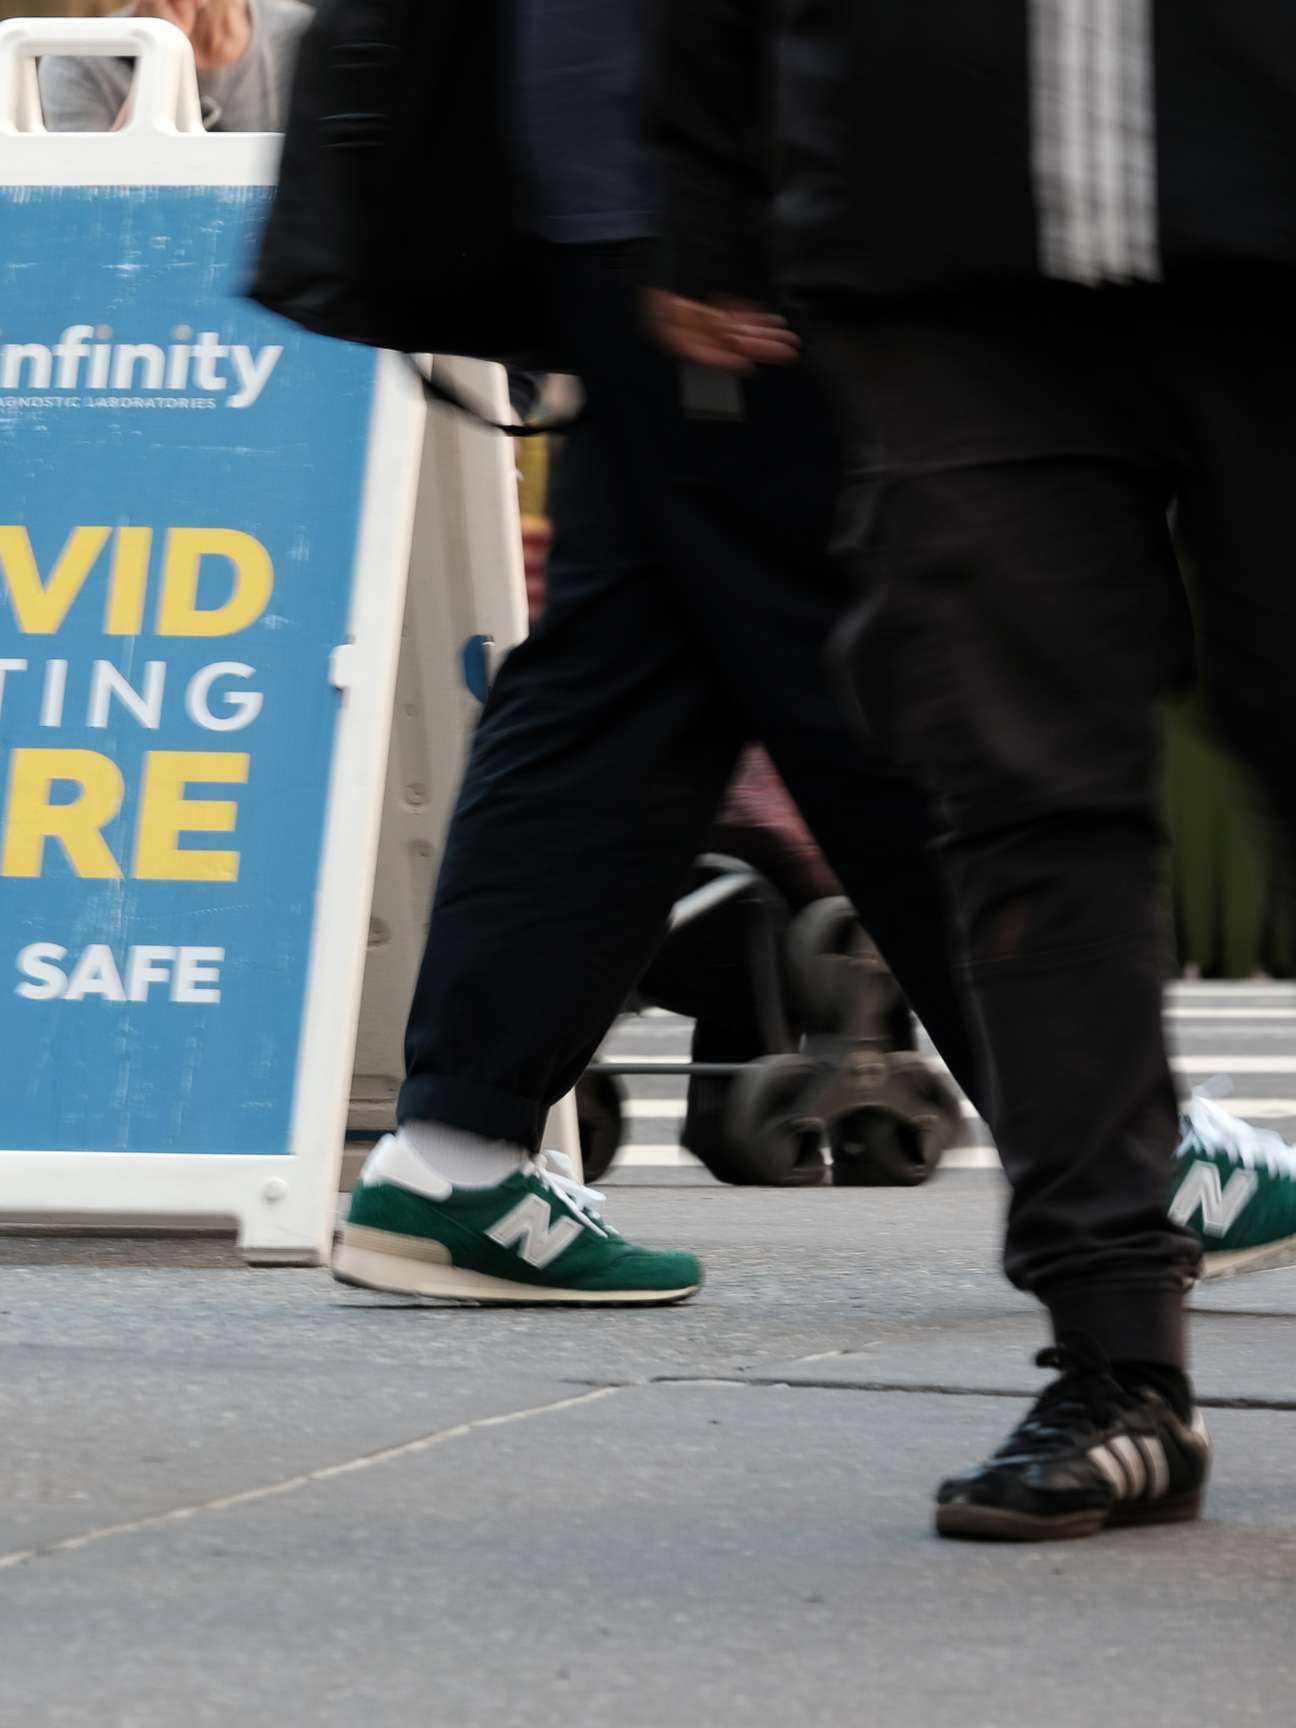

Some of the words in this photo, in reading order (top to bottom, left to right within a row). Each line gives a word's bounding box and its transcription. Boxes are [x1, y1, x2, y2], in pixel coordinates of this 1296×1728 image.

[86, 397, 217, 410] LABORATORIES
[16, 942, 224, 1004] SAFE
[485, 1193, 583, 1270] N
[1168, 1160, 1259, 1239] N
